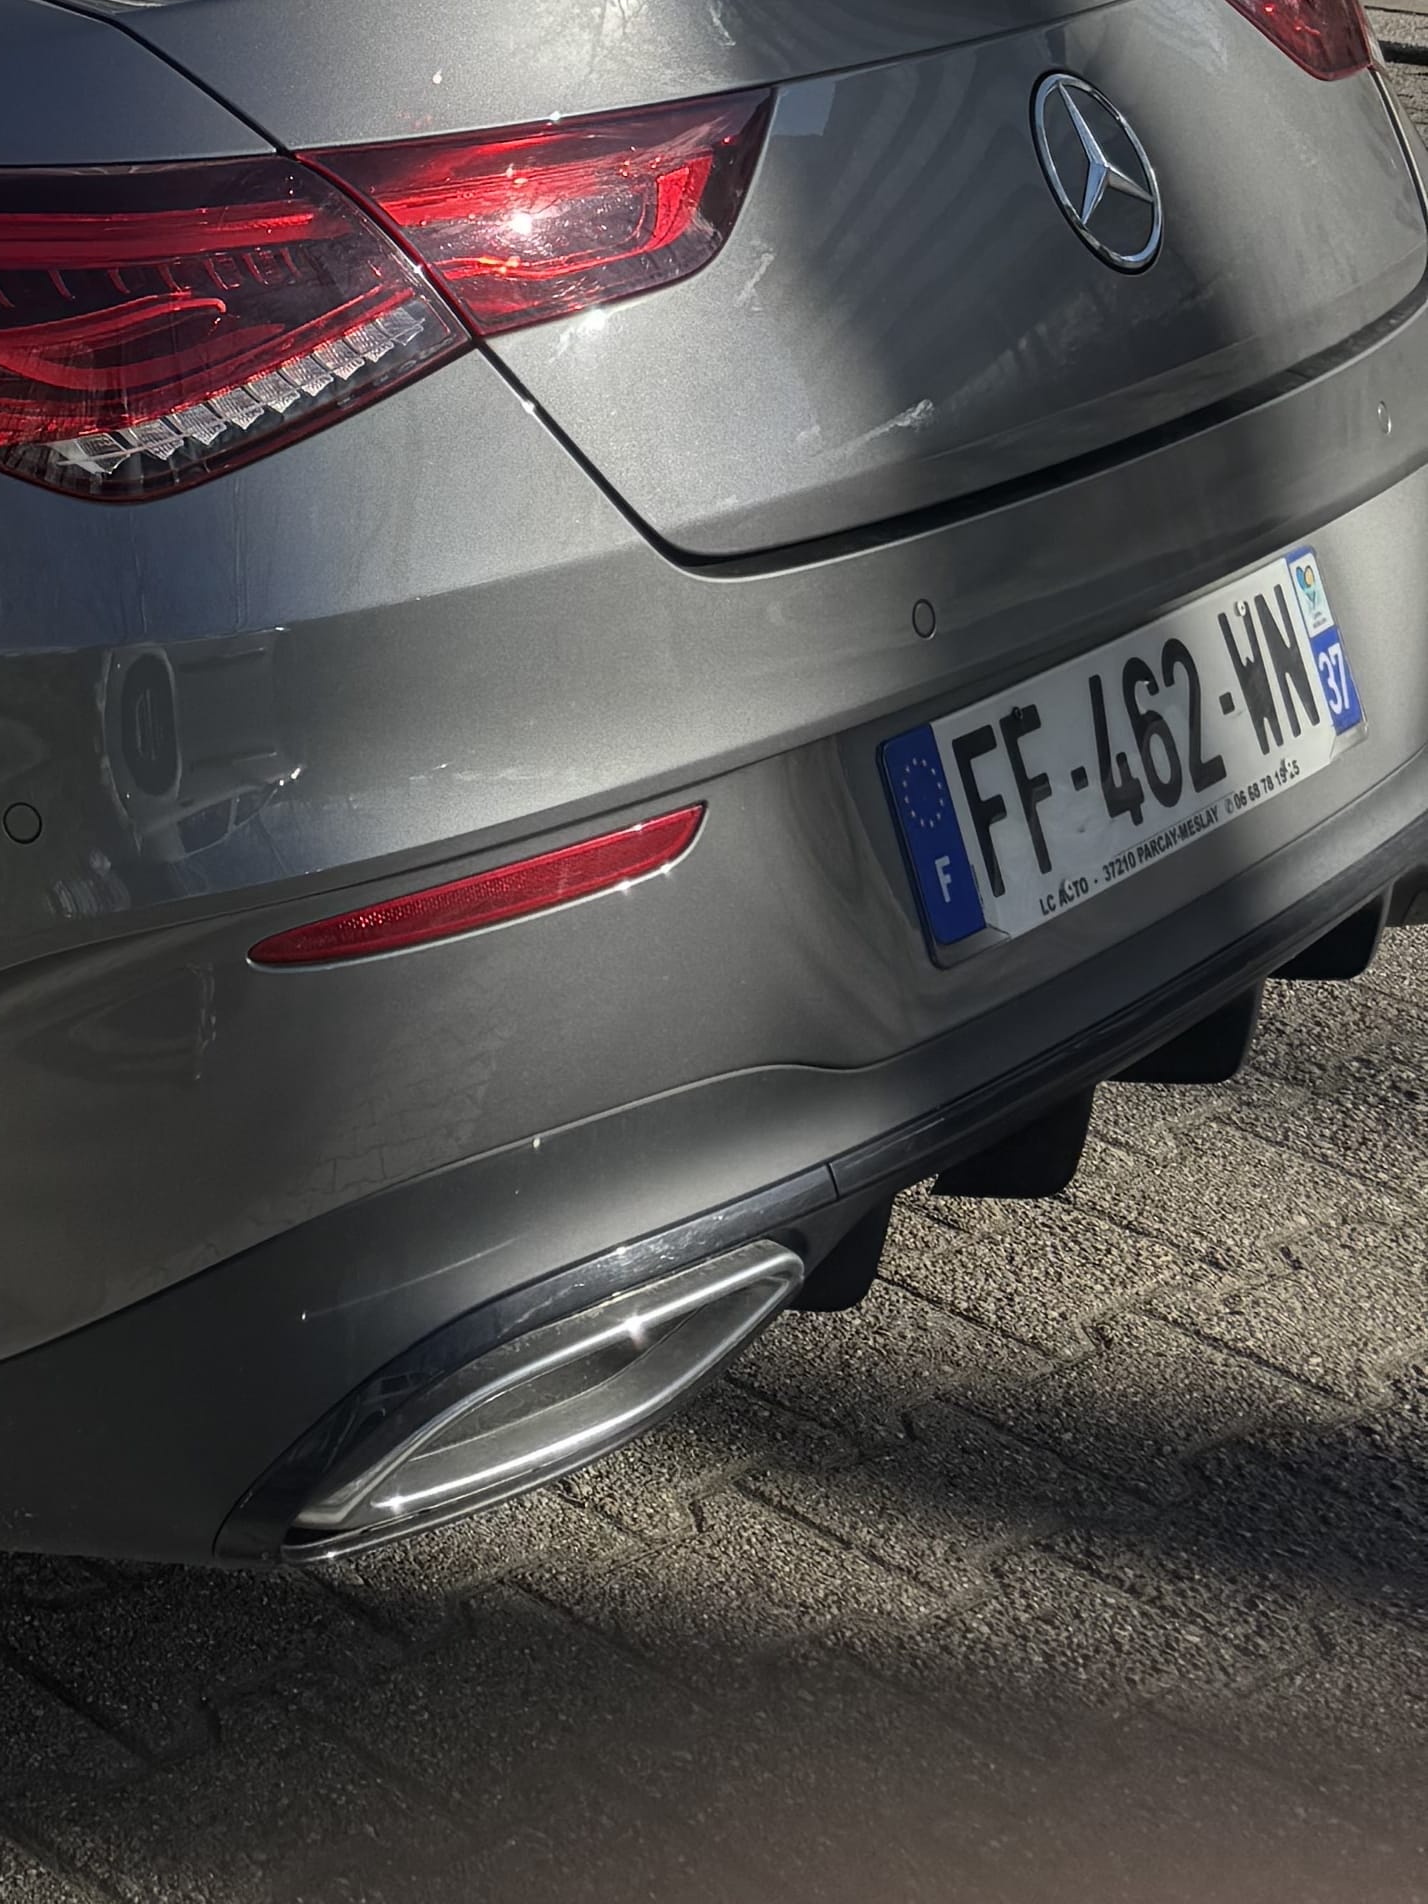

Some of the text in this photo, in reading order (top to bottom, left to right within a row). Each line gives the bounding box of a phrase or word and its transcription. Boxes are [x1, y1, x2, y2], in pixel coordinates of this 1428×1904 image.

[1318, 642, 1350, 715] 37
[952, 584, 1320, 897] FF-462-WN
[934, 855, 952, 903] F
[1039, 894, 1056, 916] LC
[1103, 851, 1137, 882] 37210
[1233, 790, 1248, 810] 06
[1260, 775, 1274, 794] 78
